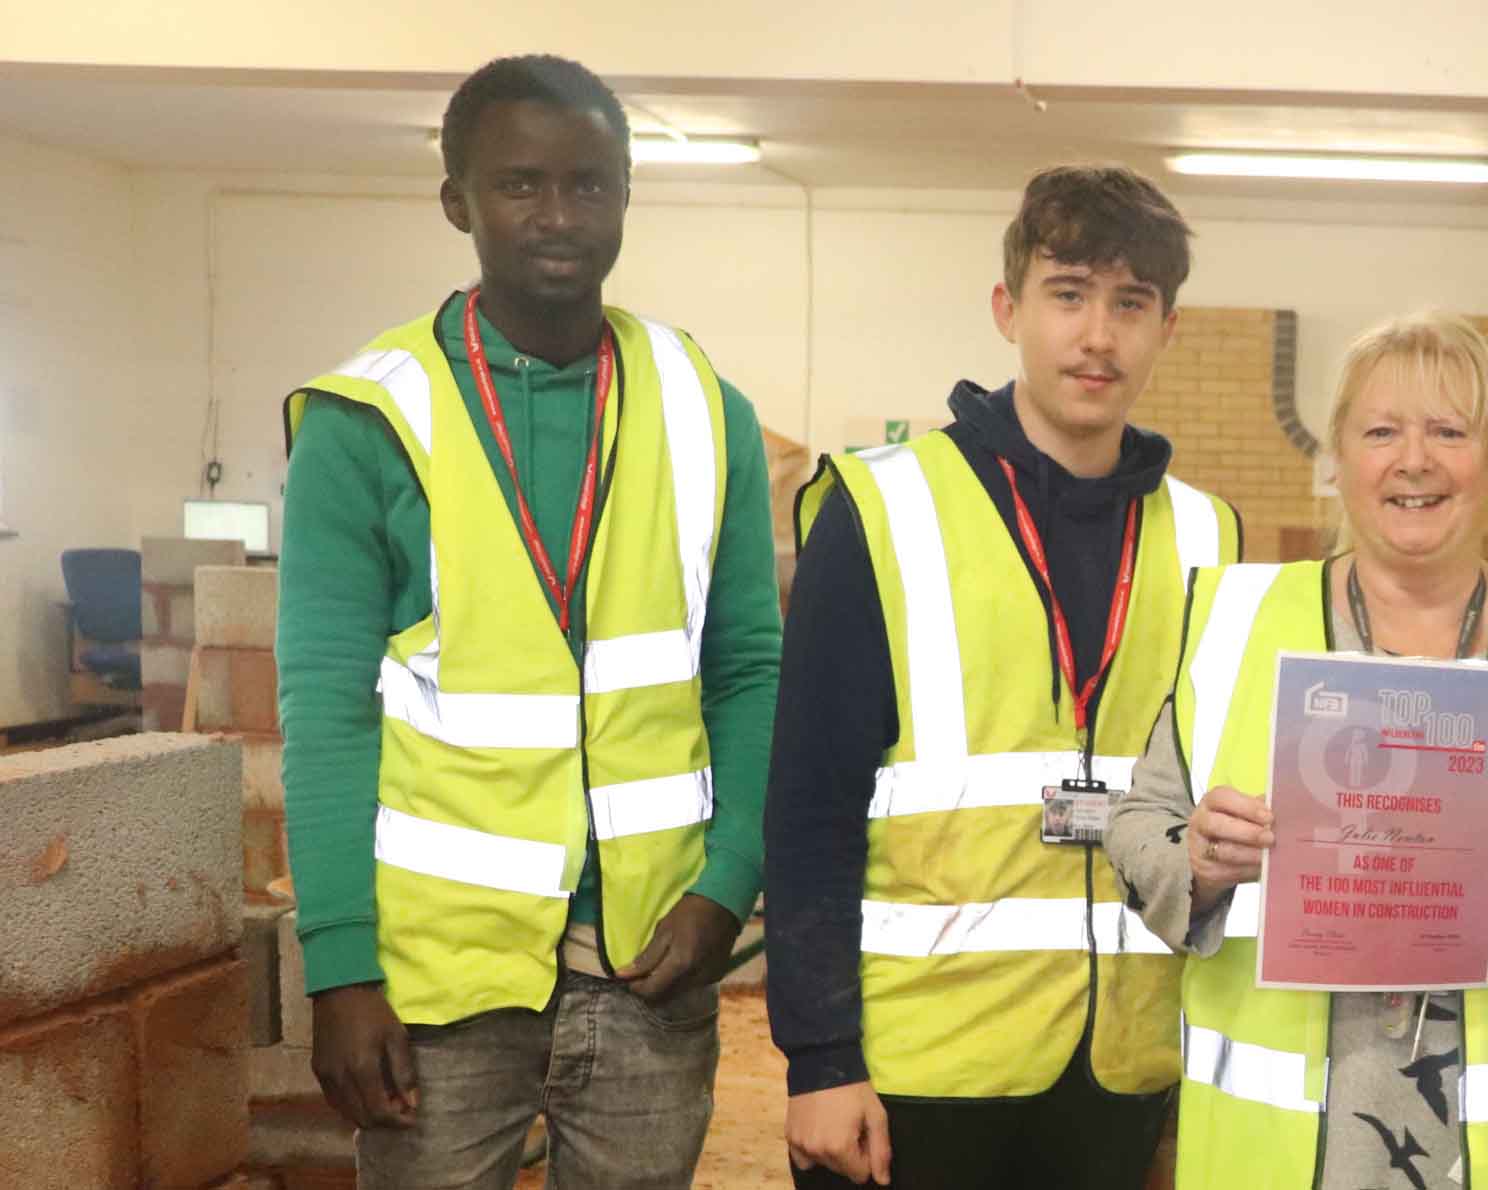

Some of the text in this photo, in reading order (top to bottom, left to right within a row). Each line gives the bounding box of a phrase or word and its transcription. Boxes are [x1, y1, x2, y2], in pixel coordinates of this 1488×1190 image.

[1378, 689, 1431, 727] TOP
[1425, 713, 1474, 747] 100
[1448, 756, 1484, 774] 2023
[1336, 792, 1441, 814] THIS RECOGNISES
[1353, 855, 1416, 872] AS ONE OF
[1299, 874, 1464, 897] THE 100 MOST INFLUENTIAL
[1303, 900, 1458, 920] WOMEN IN CONSTRUCTION
